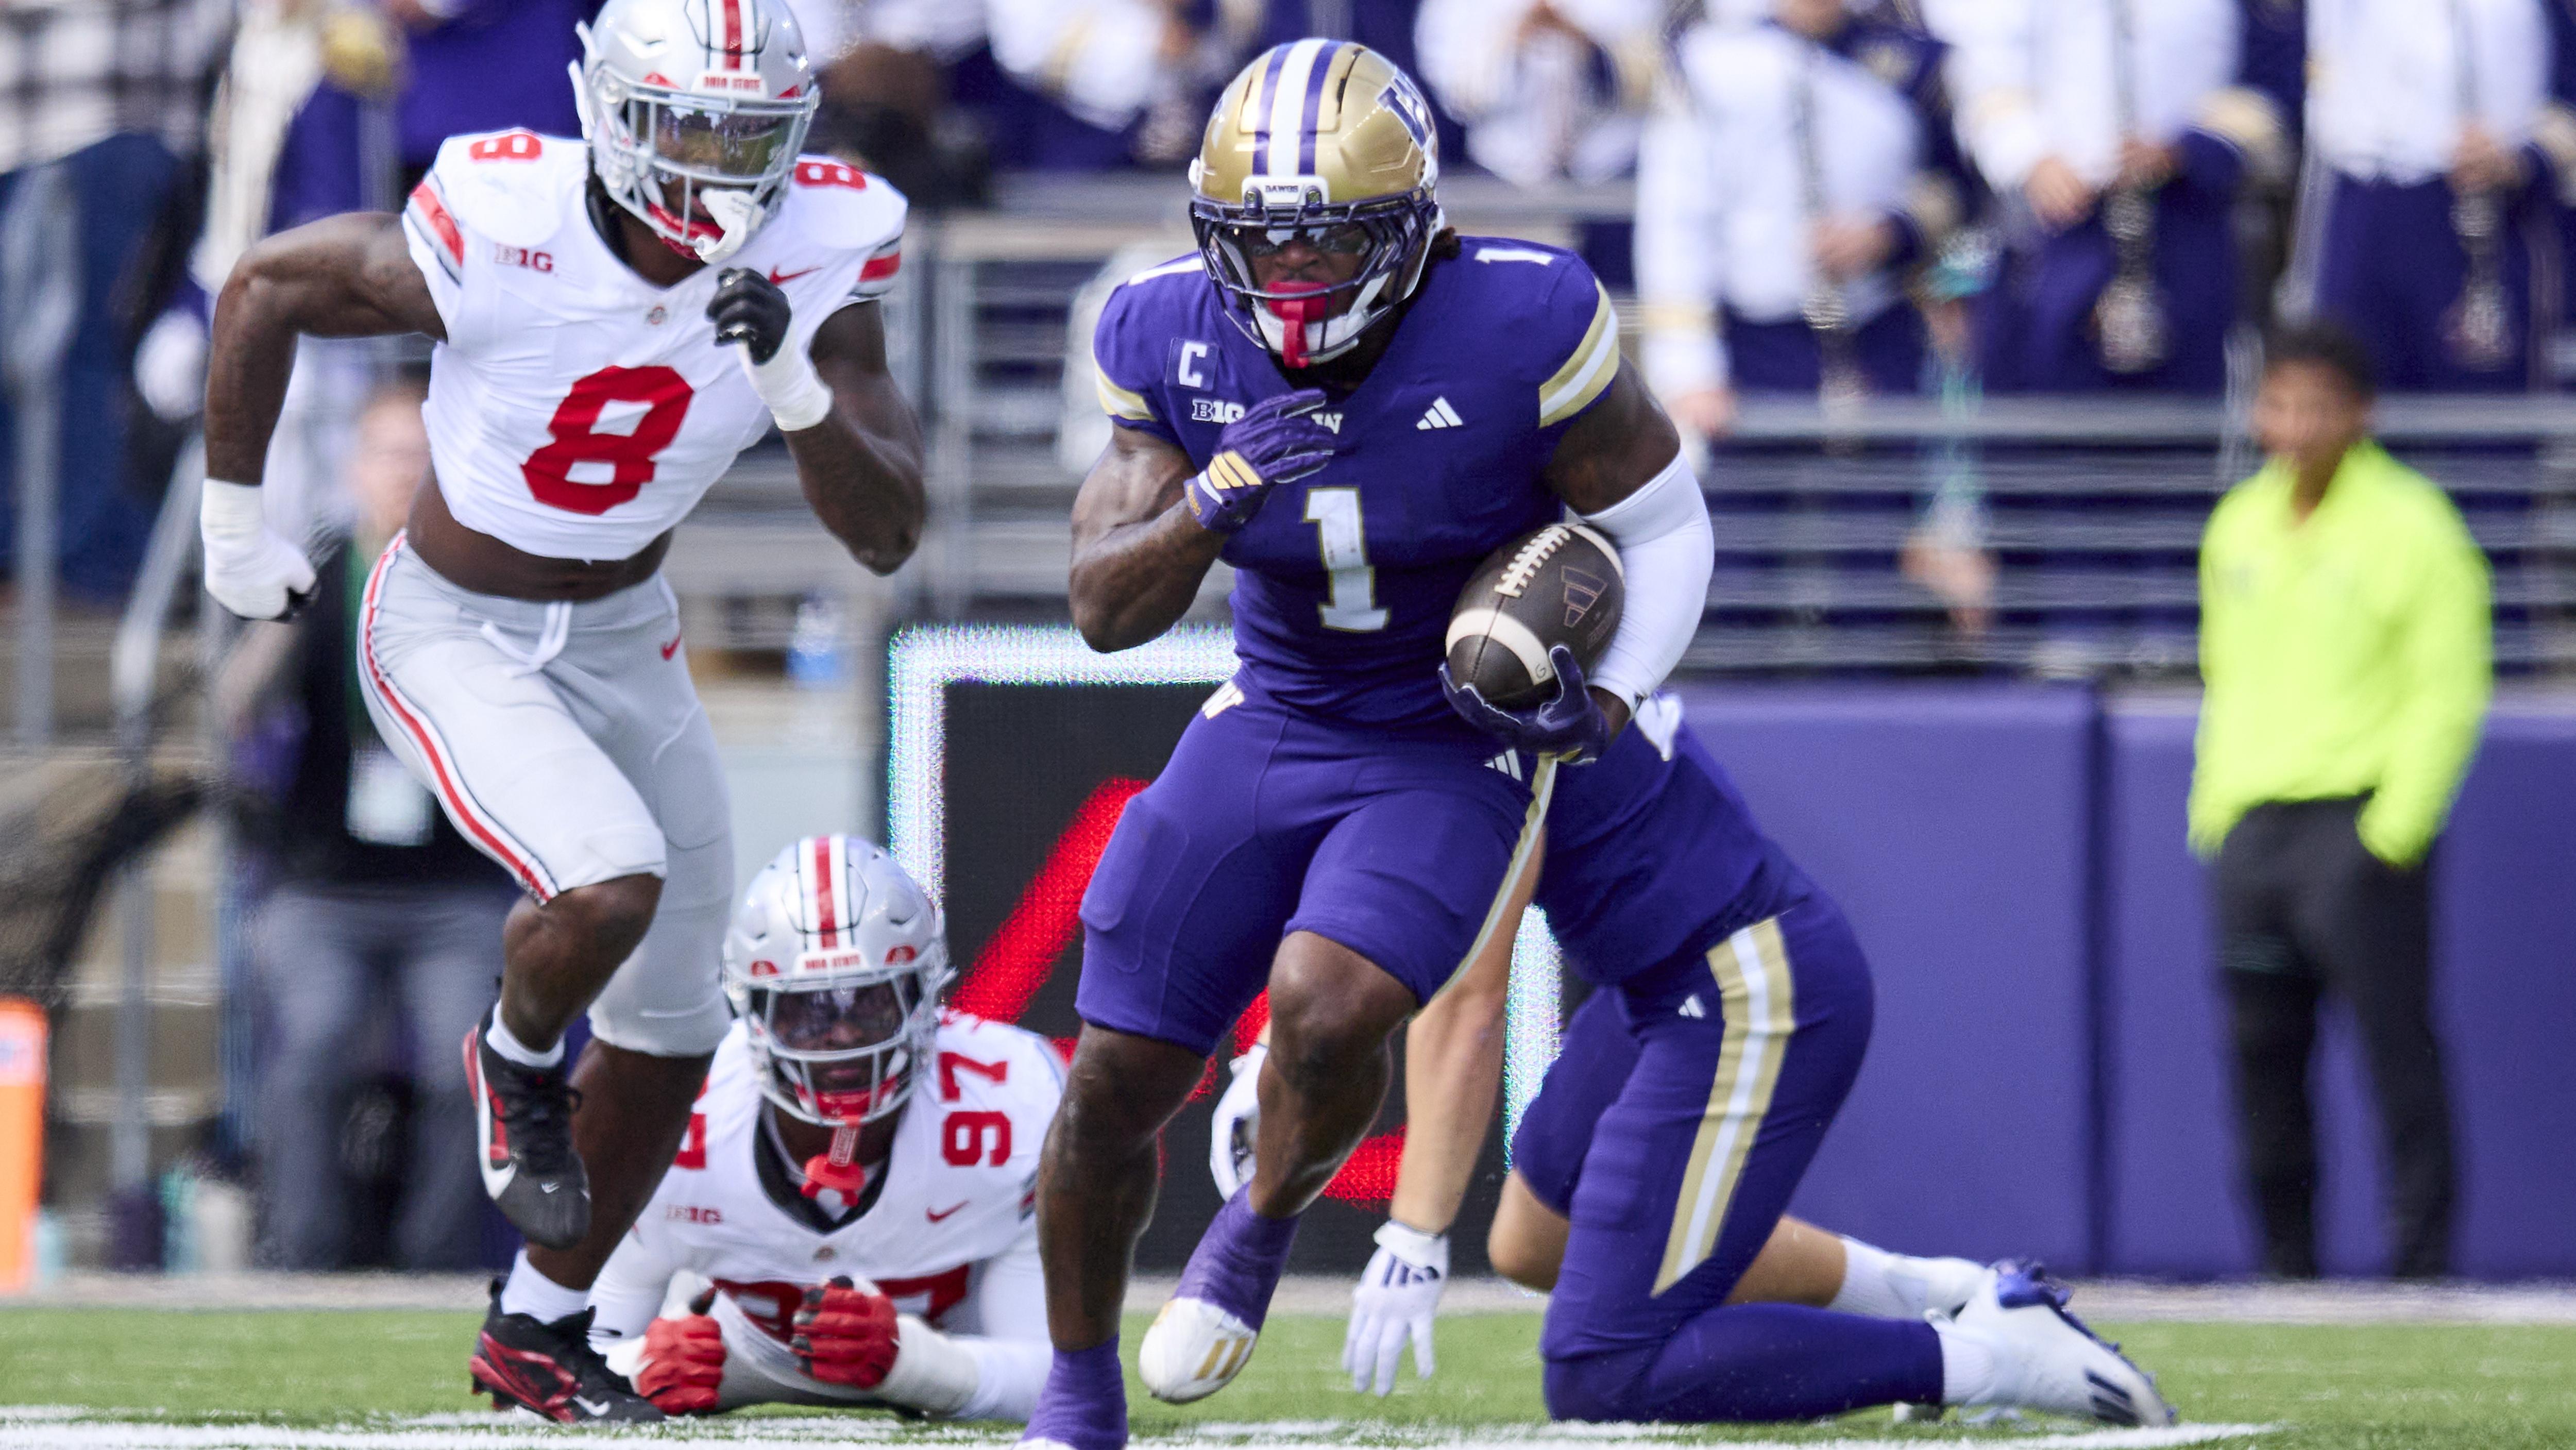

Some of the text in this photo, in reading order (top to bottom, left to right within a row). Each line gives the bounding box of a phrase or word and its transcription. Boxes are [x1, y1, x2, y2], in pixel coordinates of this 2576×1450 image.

[470, 134, 543, 161] 8
[794, 161, 867, 190] 8
[1265, 184, 1299, 193] DAWGS
[1178, 342, 1207, 387] C
[520, 365, 694, 515] 8
[1303, 486, 1391, 633] 1
[938, 1052, 1011, 1167] 97
